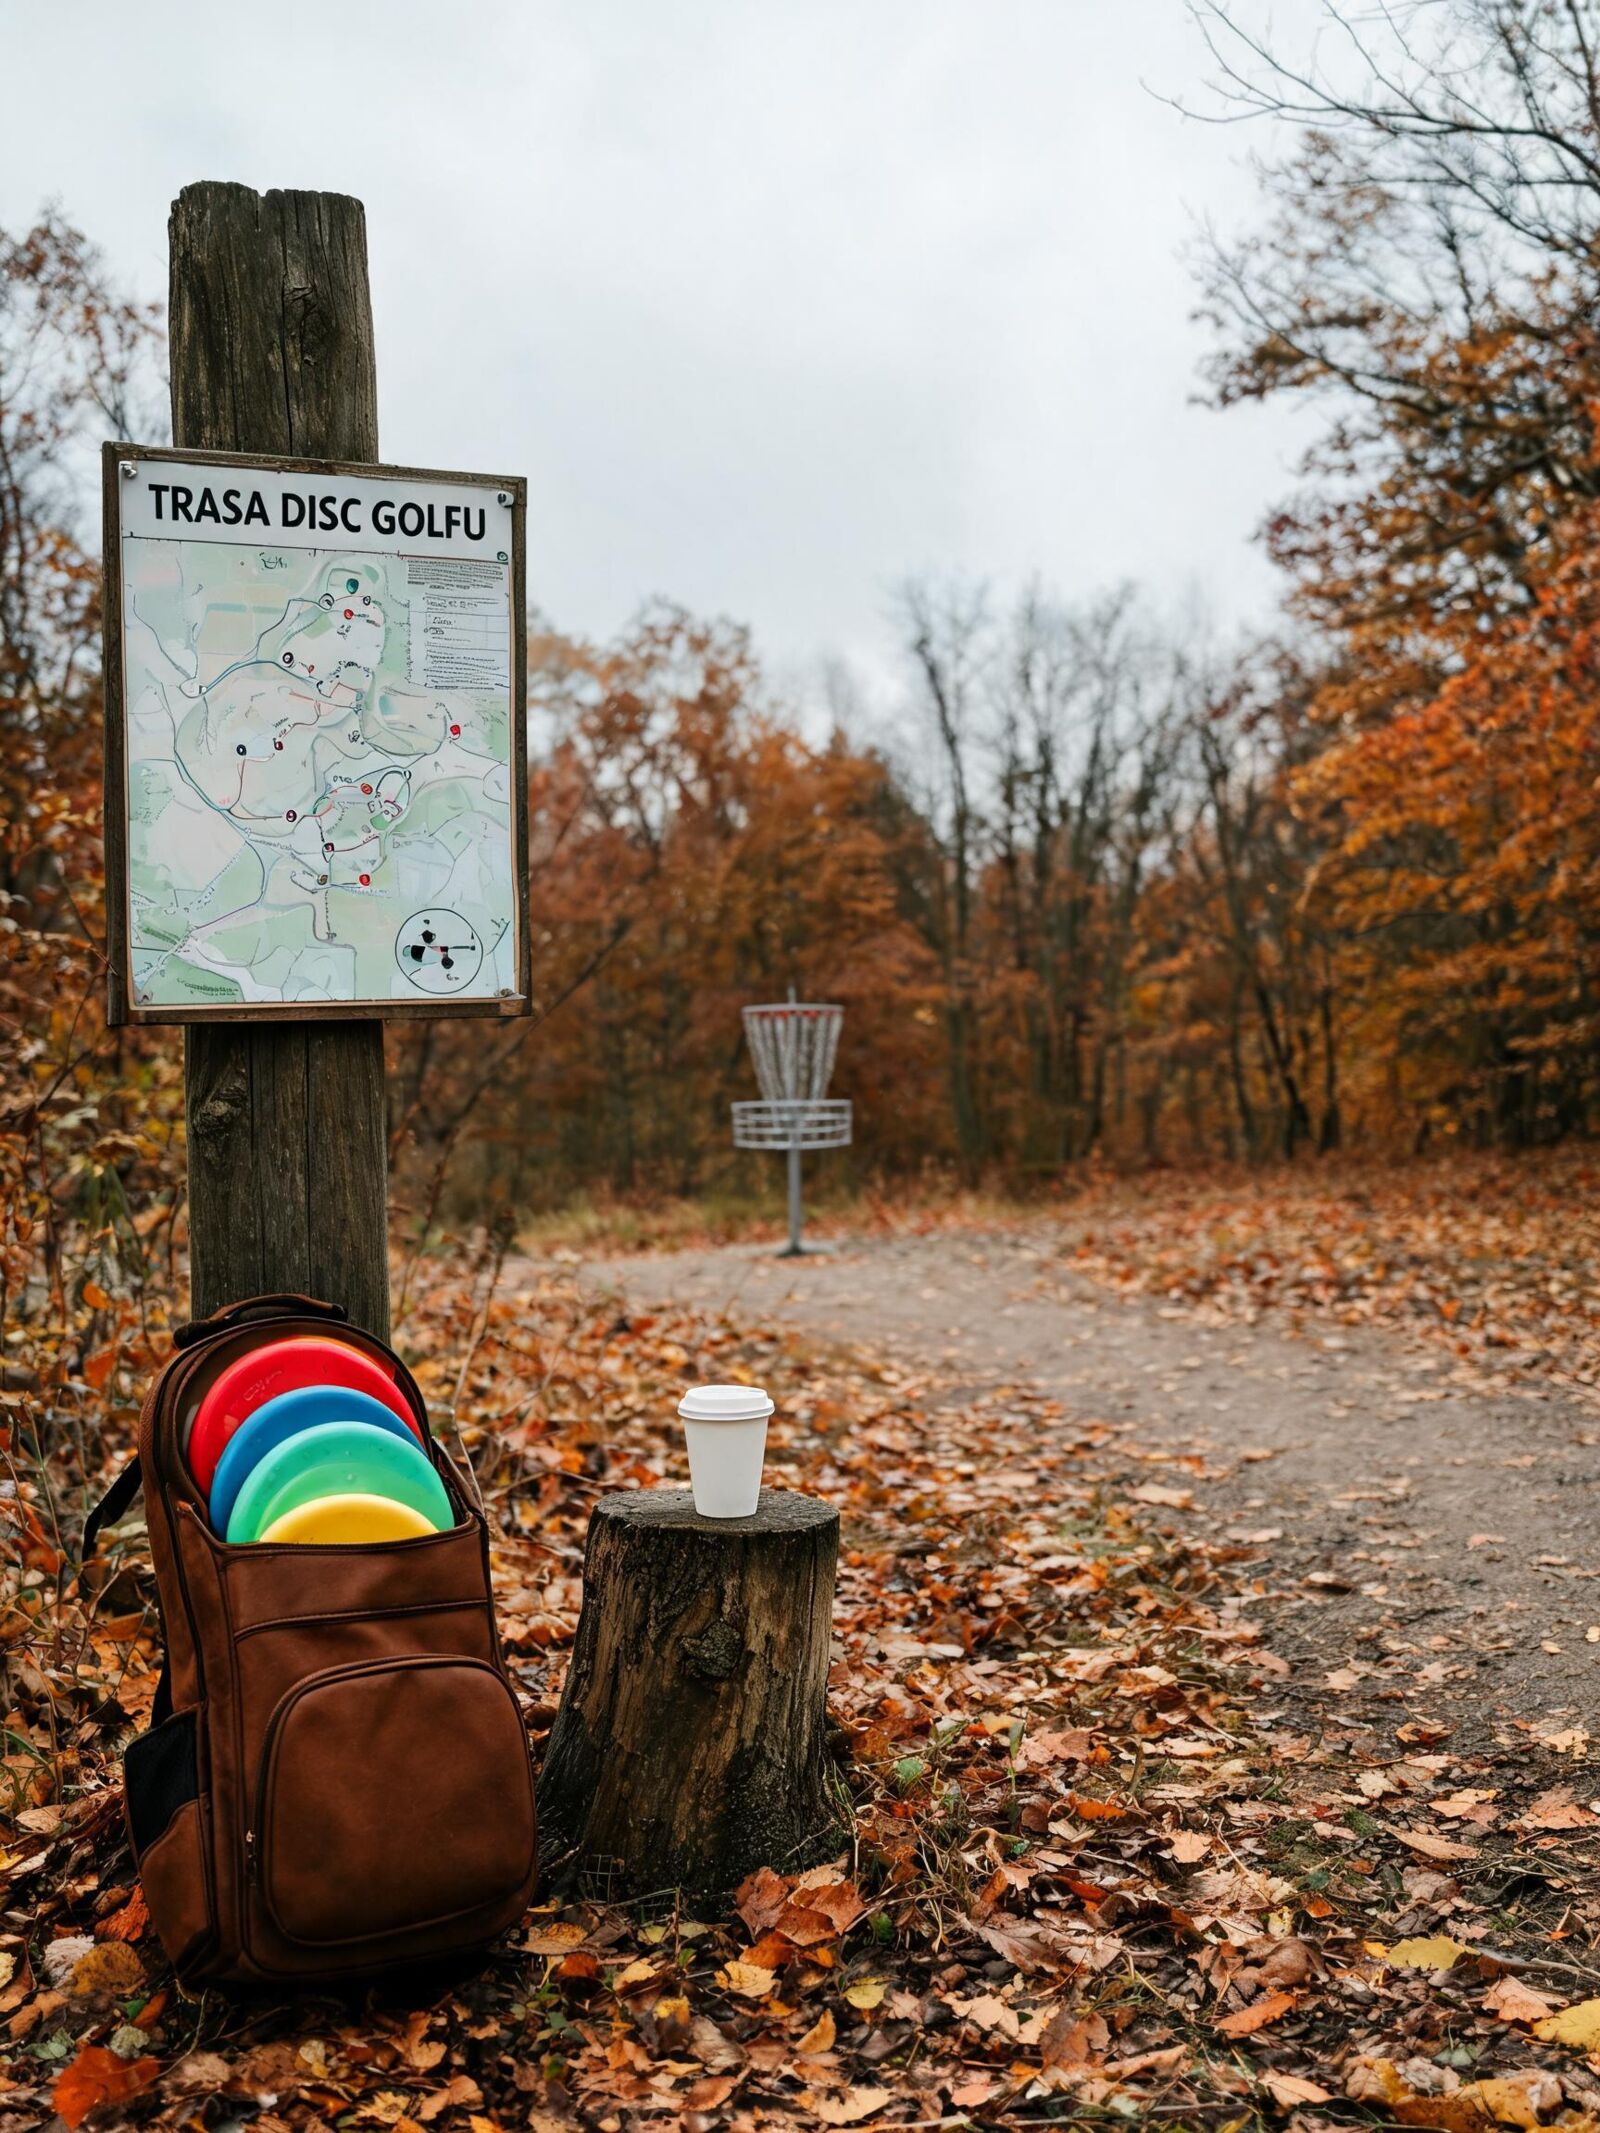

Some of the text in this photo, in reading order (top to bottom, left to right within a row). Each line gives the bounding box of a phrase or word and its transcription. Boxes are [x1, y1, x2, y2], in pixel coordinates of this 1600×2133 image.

[148, 484, 486, 540] TRASA DISC GOLFU
